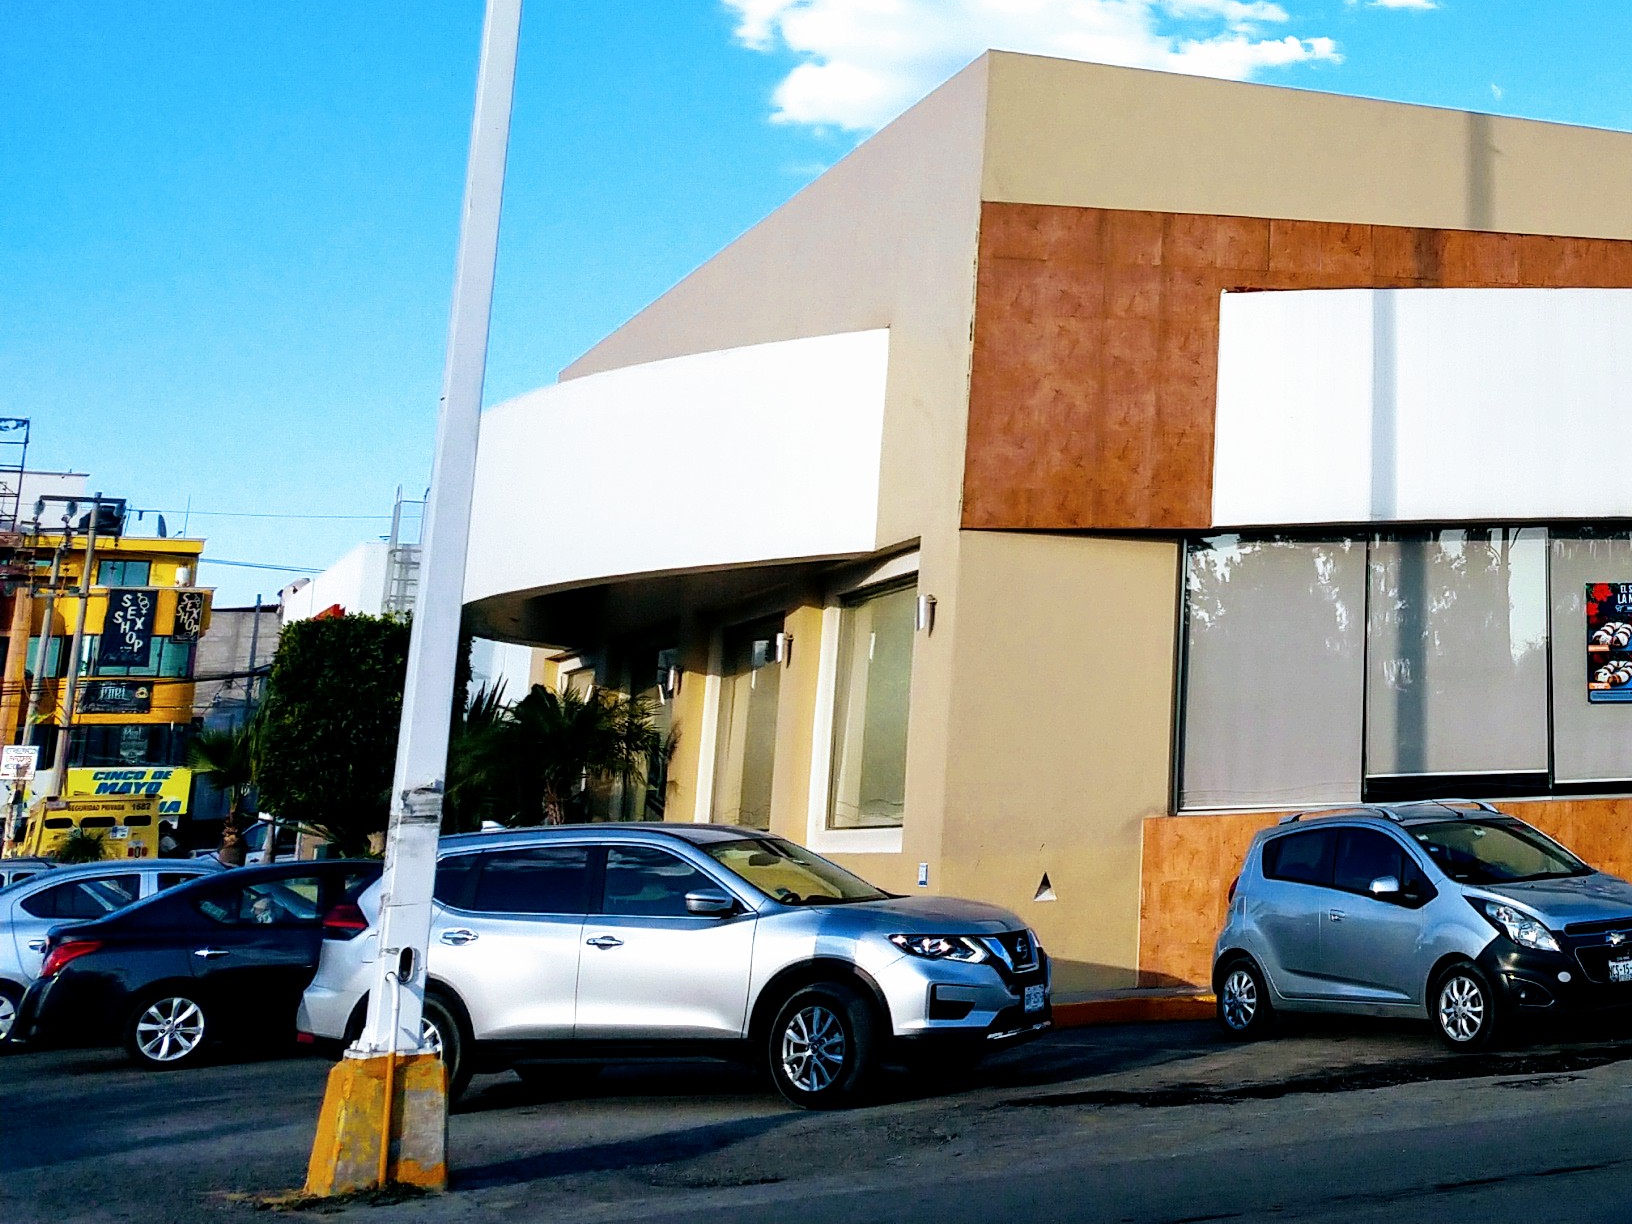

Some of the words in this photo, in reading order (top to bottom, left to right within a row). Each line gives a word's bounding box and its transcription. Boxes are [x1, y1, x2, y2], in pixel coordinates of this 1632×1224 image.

[1617, 593, 1627, 604] LA
[1620, 584, 1627, 593] EL
[121, 594, 144, 630] SEX
[181, 592, 200, 619] SEX
[176, 604, 199, 636] SHOP
[113, 611, 143, 652] SHOP
[92, 771, 147, 781] CINCO
[151, 770, 173, 779] DE
[95, 782, 163, 795] MAYO
